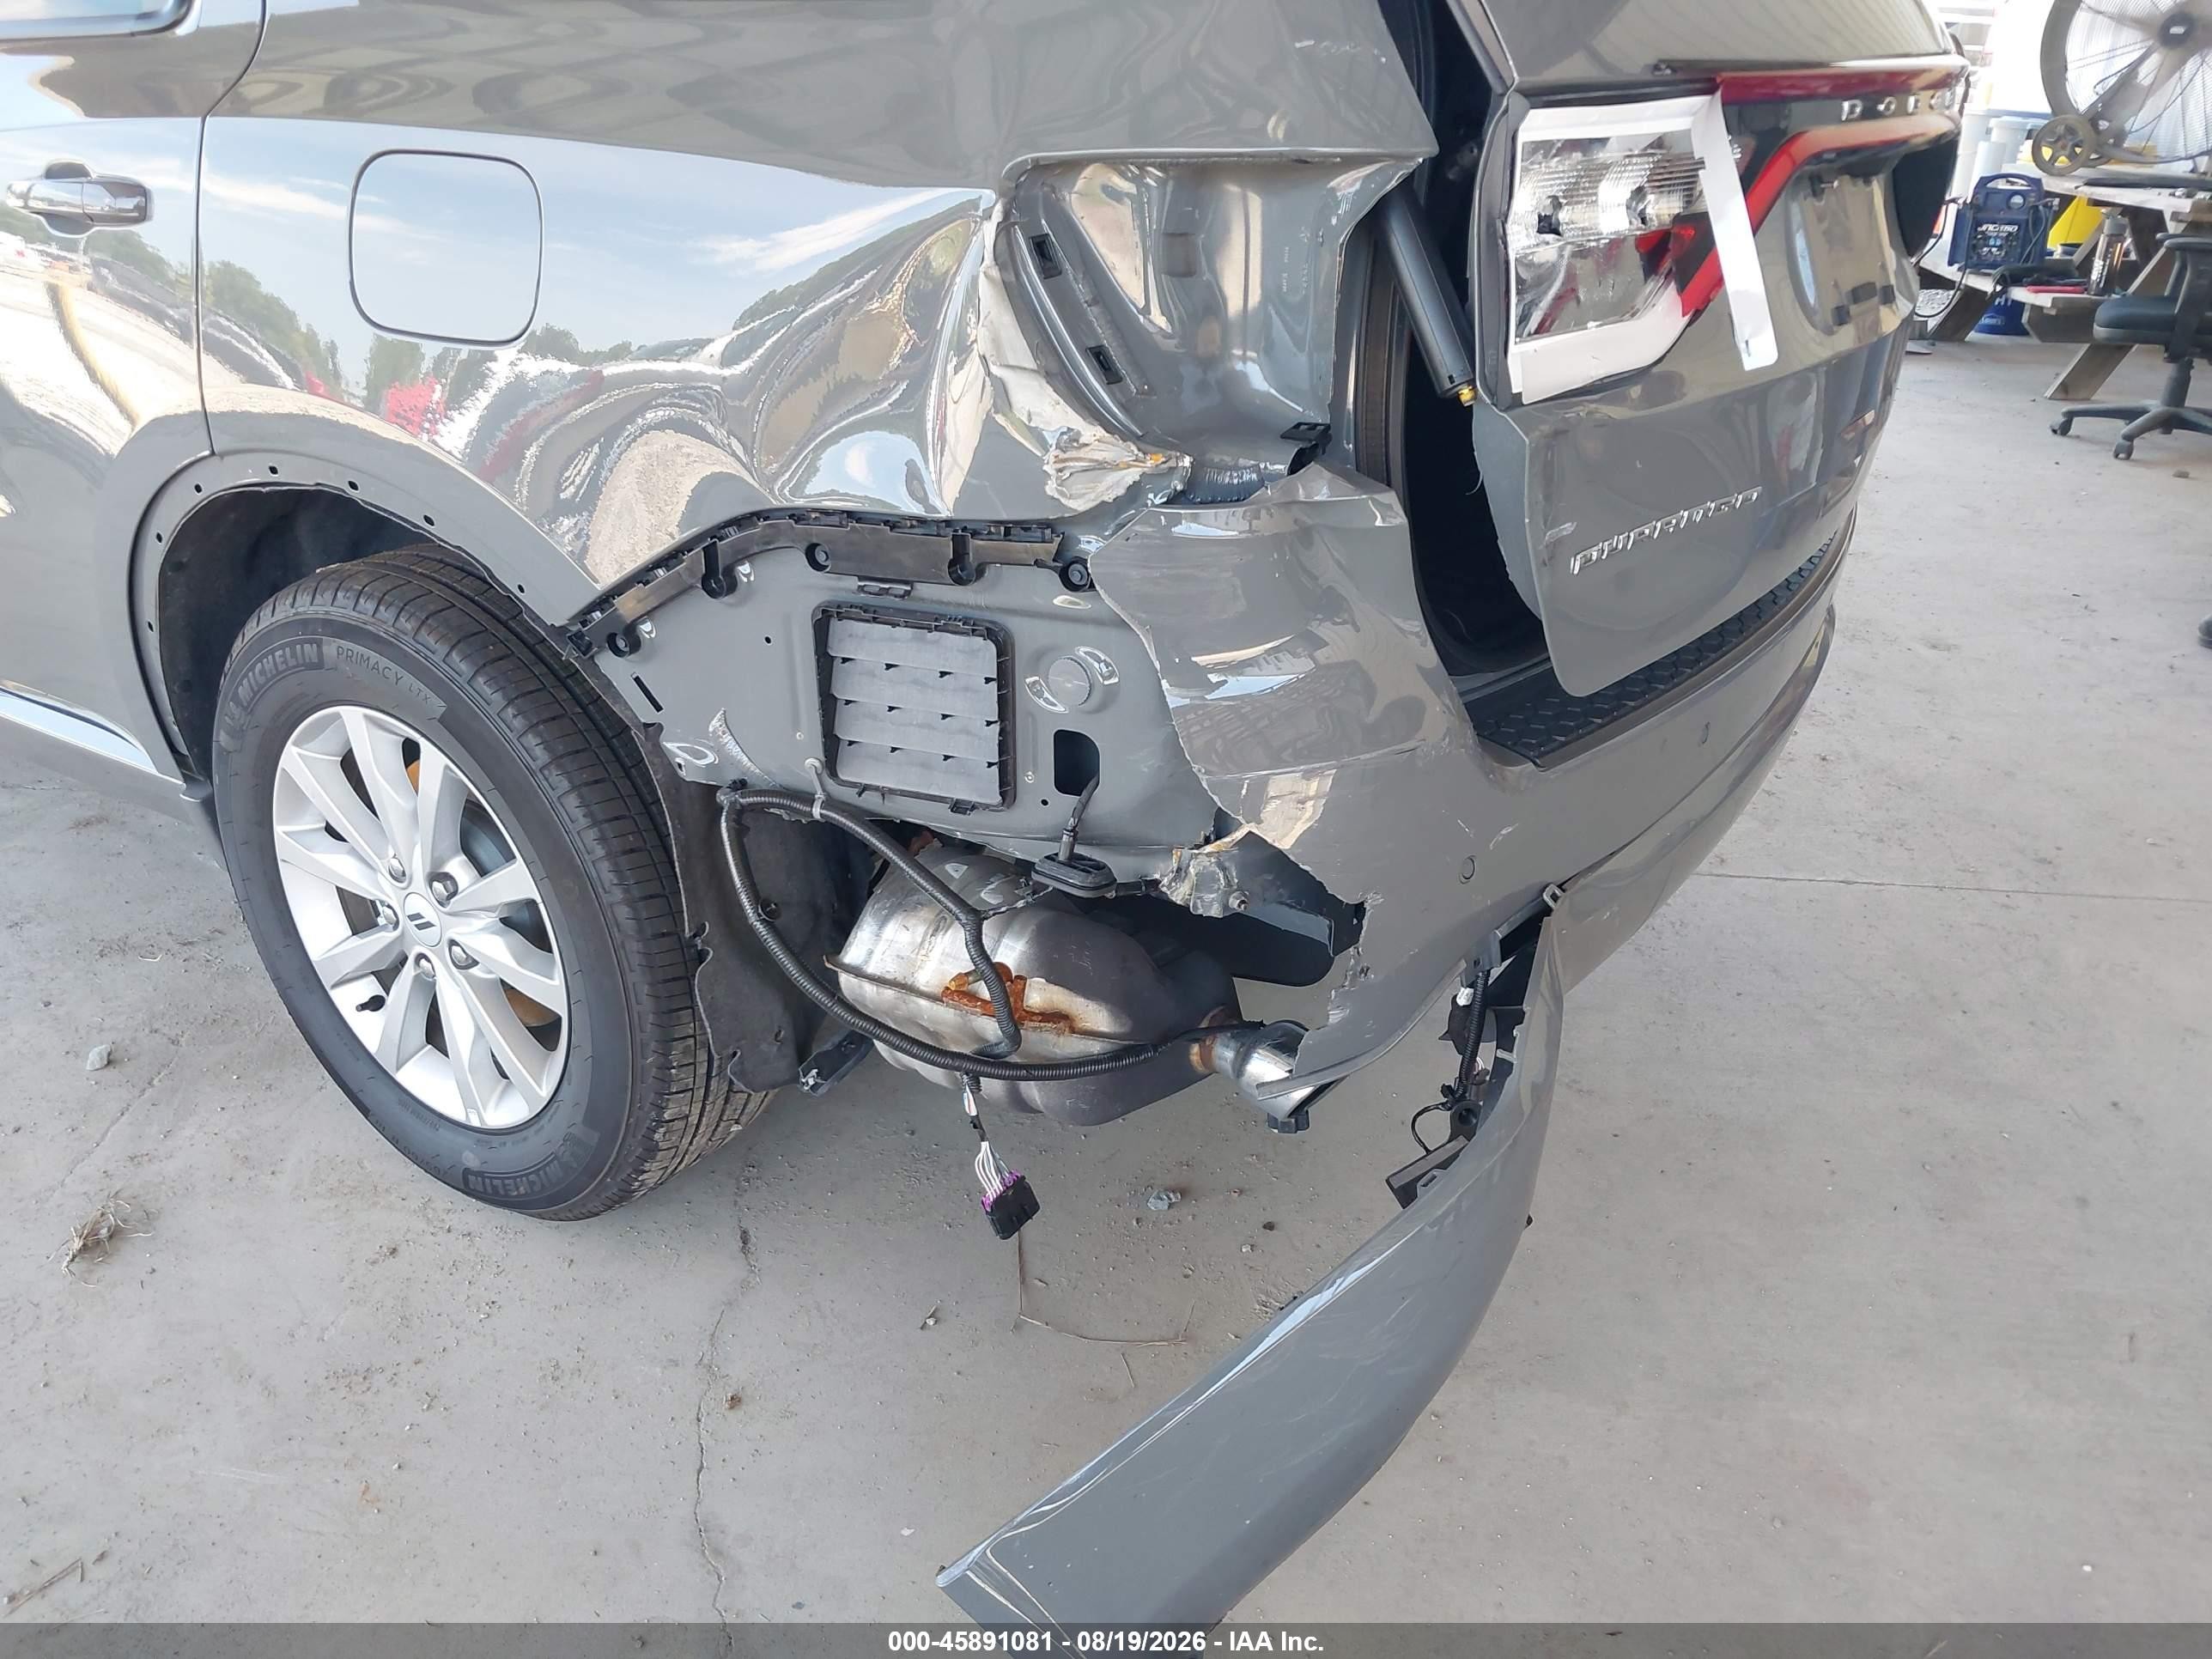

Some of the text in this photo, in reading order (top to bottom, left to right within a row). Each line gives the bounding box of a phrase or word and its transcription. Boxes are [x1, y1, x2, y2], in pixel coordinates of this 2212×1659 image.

[1570, 486, 1763, 575] DURANGO
[237, 642, 431, 705] MICHELIN PRIMACY LTX
[467, 1161, 564, 1196] MICHELIN
